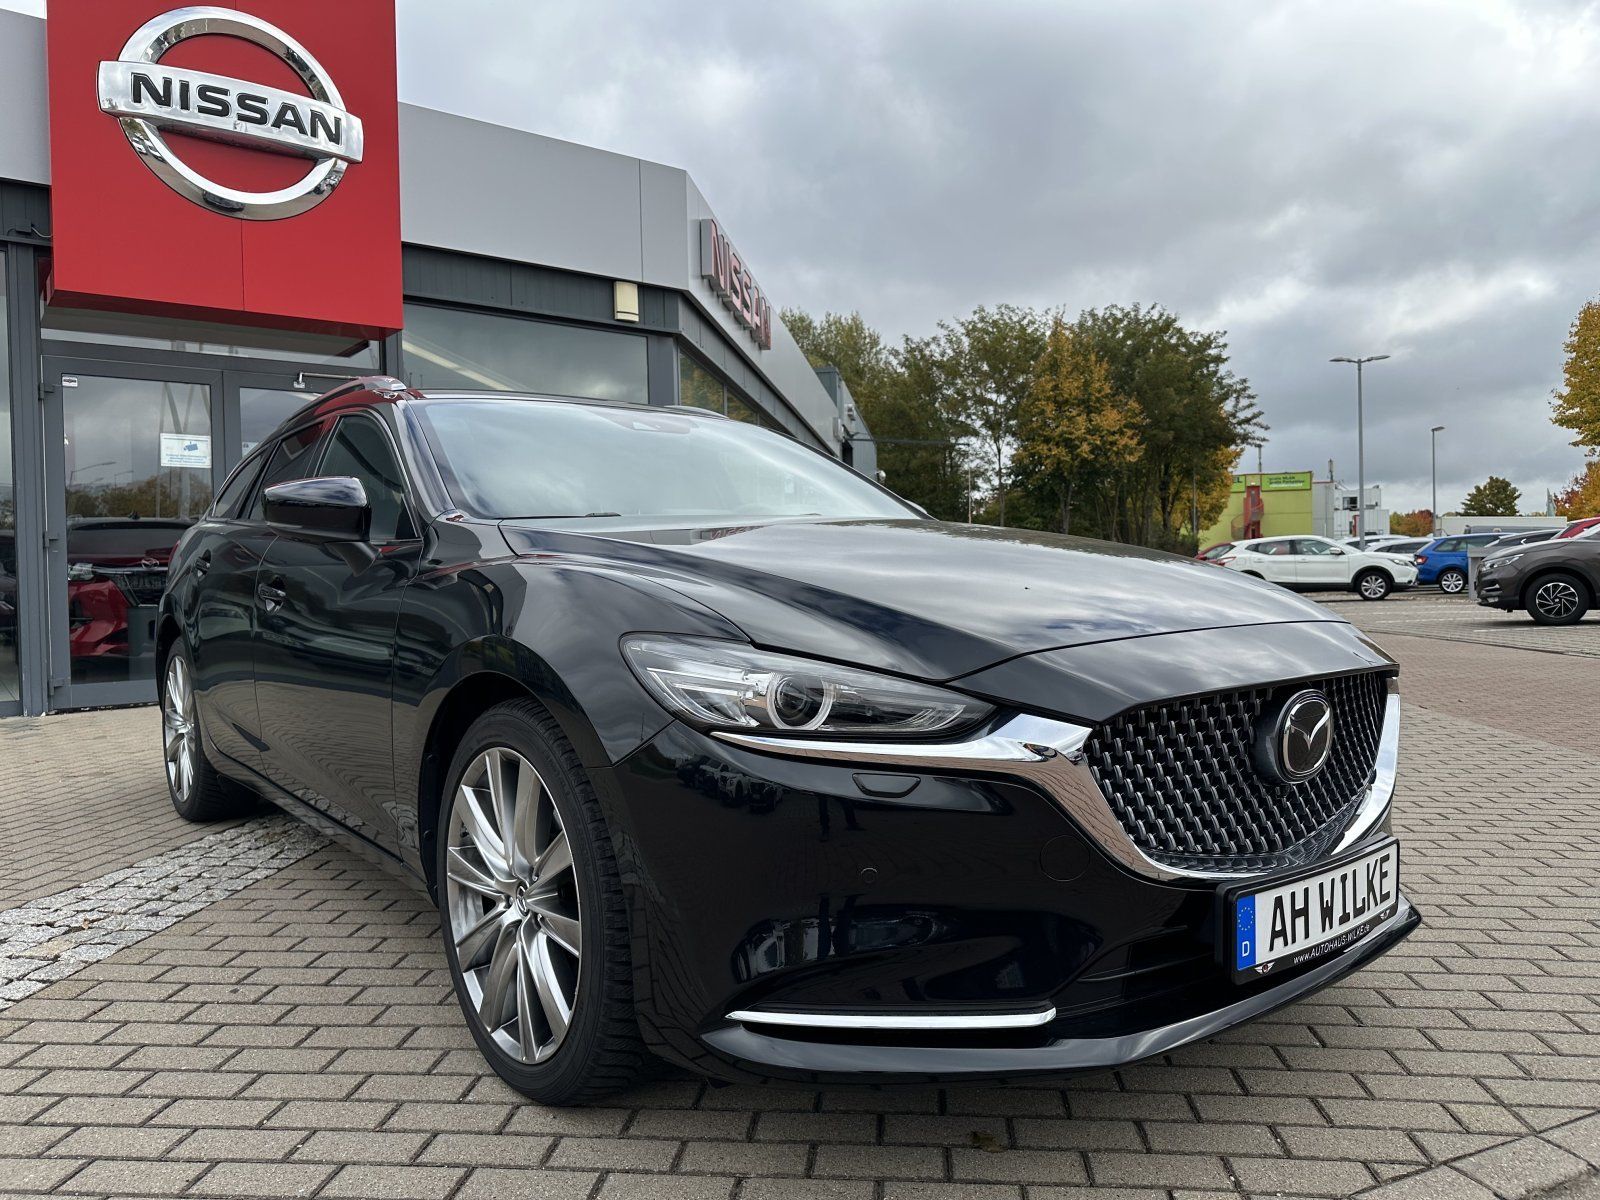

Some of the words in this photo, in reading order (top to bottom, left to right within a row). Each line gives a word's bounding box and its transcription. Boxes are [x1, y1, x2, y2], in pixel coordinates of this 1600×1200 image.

[131, 72, 344, 147] NISSAN
[700, 218, 771, 350] NISSAN
[1268, 886, 1310, 952] AH
[1318, 852, 1391, 933] WILKE
[1241, 940, 1250, 957] D
